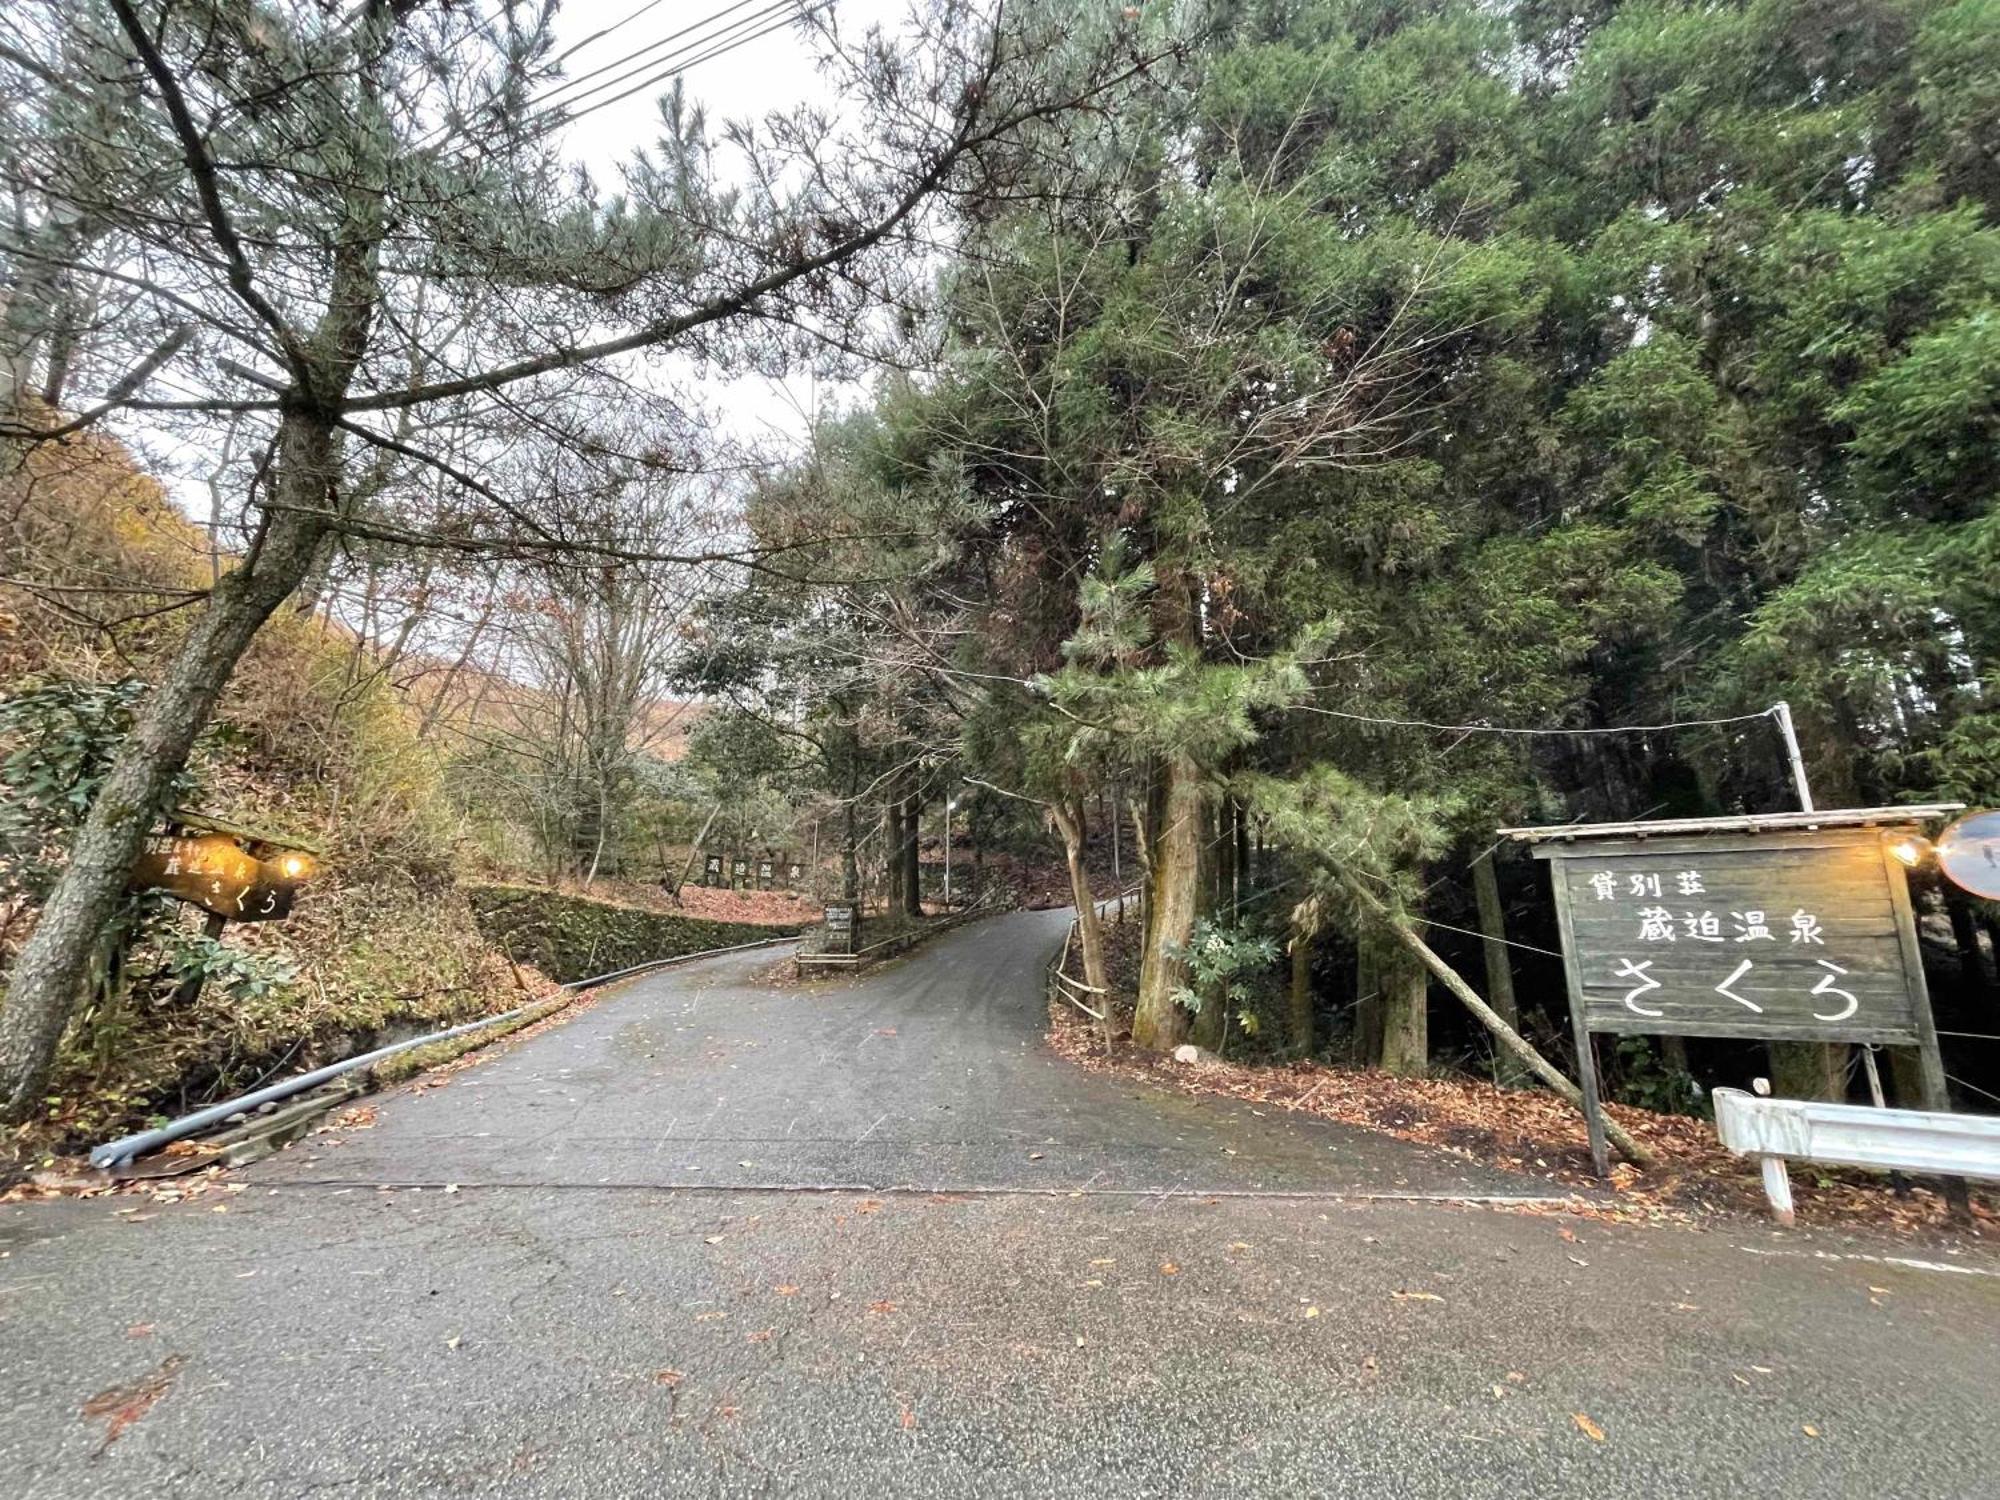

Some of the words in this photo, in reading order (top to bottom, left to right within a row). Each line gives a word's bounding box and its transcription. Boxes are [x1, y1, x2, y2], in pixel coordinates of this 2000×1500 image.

[1588, 871, 1706, 901] 貸別荘
[1637, 906, 1825, 945] 蔵迫温泉
[1614, 958, 1859, 1022] さくら
